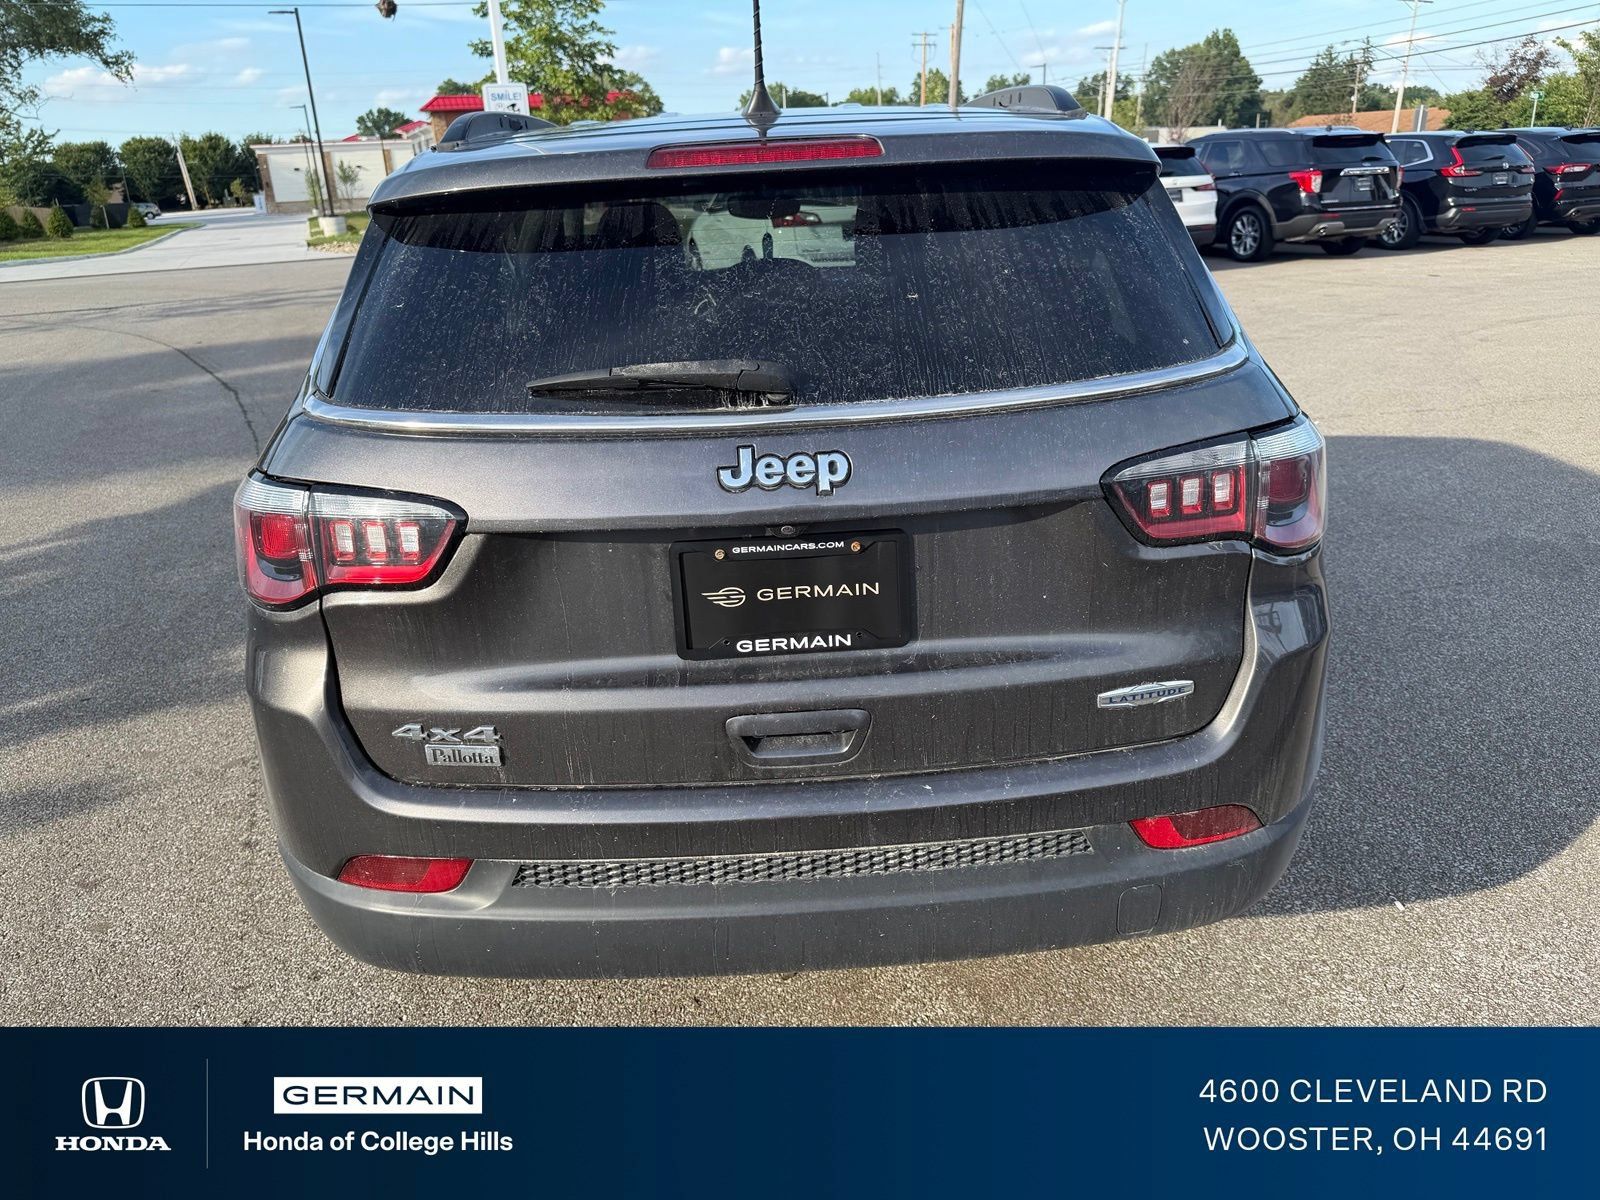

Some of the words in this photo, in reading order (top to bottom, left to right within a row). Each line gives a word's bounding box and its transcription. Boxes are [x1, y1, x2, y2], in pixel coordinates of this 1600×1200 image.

[717, 444, 853, 496] Jeep
[732, 541, 845, 554] GERMAINCARS.COM
[757, 582, 880, 601] GERMAIN
[736, 634, 852, 653] GERMAIN
[1109, 687, 1186, 704] LATITUDE
[431, 748, 496, 764] Pallotta
